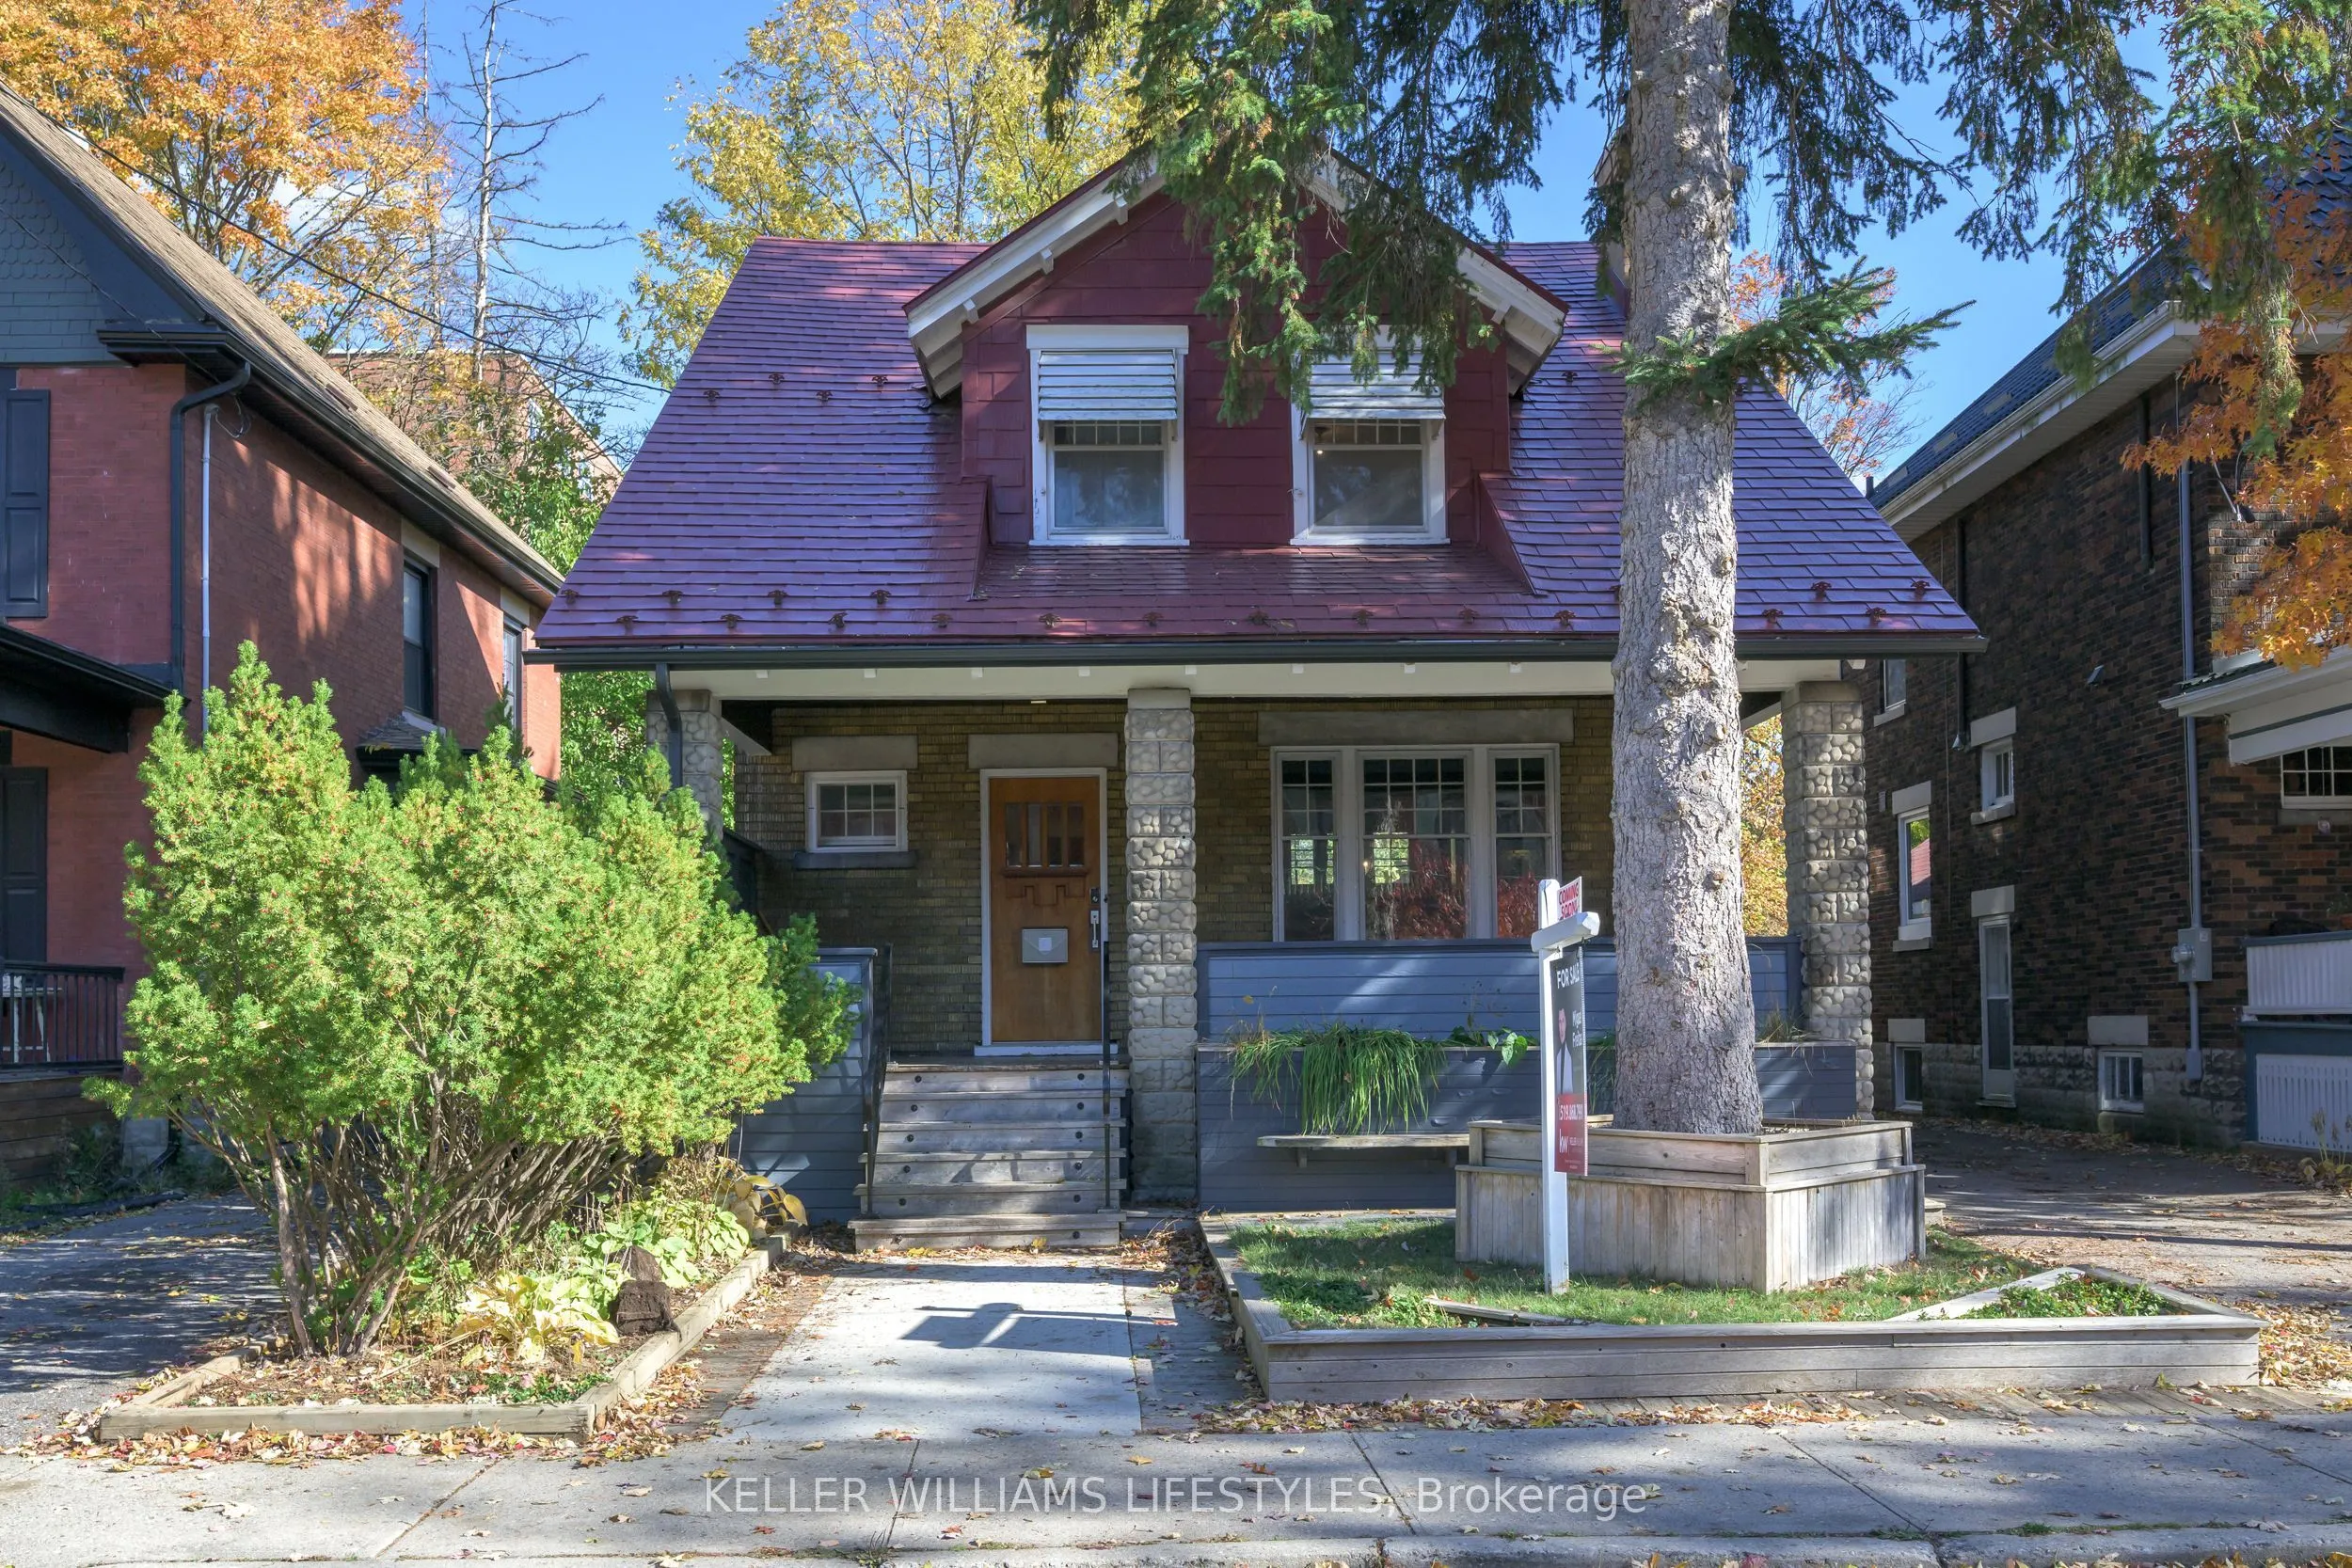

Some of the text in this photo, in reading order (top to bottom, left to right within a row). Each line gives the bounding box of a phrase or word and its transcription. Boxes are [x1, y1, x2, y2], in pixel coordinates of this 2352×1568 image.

[1559, 882, 1580, 905] COMING
[1557, 962, 1580, 989] FOR SALE
[1560, 1128, 1568, 1153] kw
